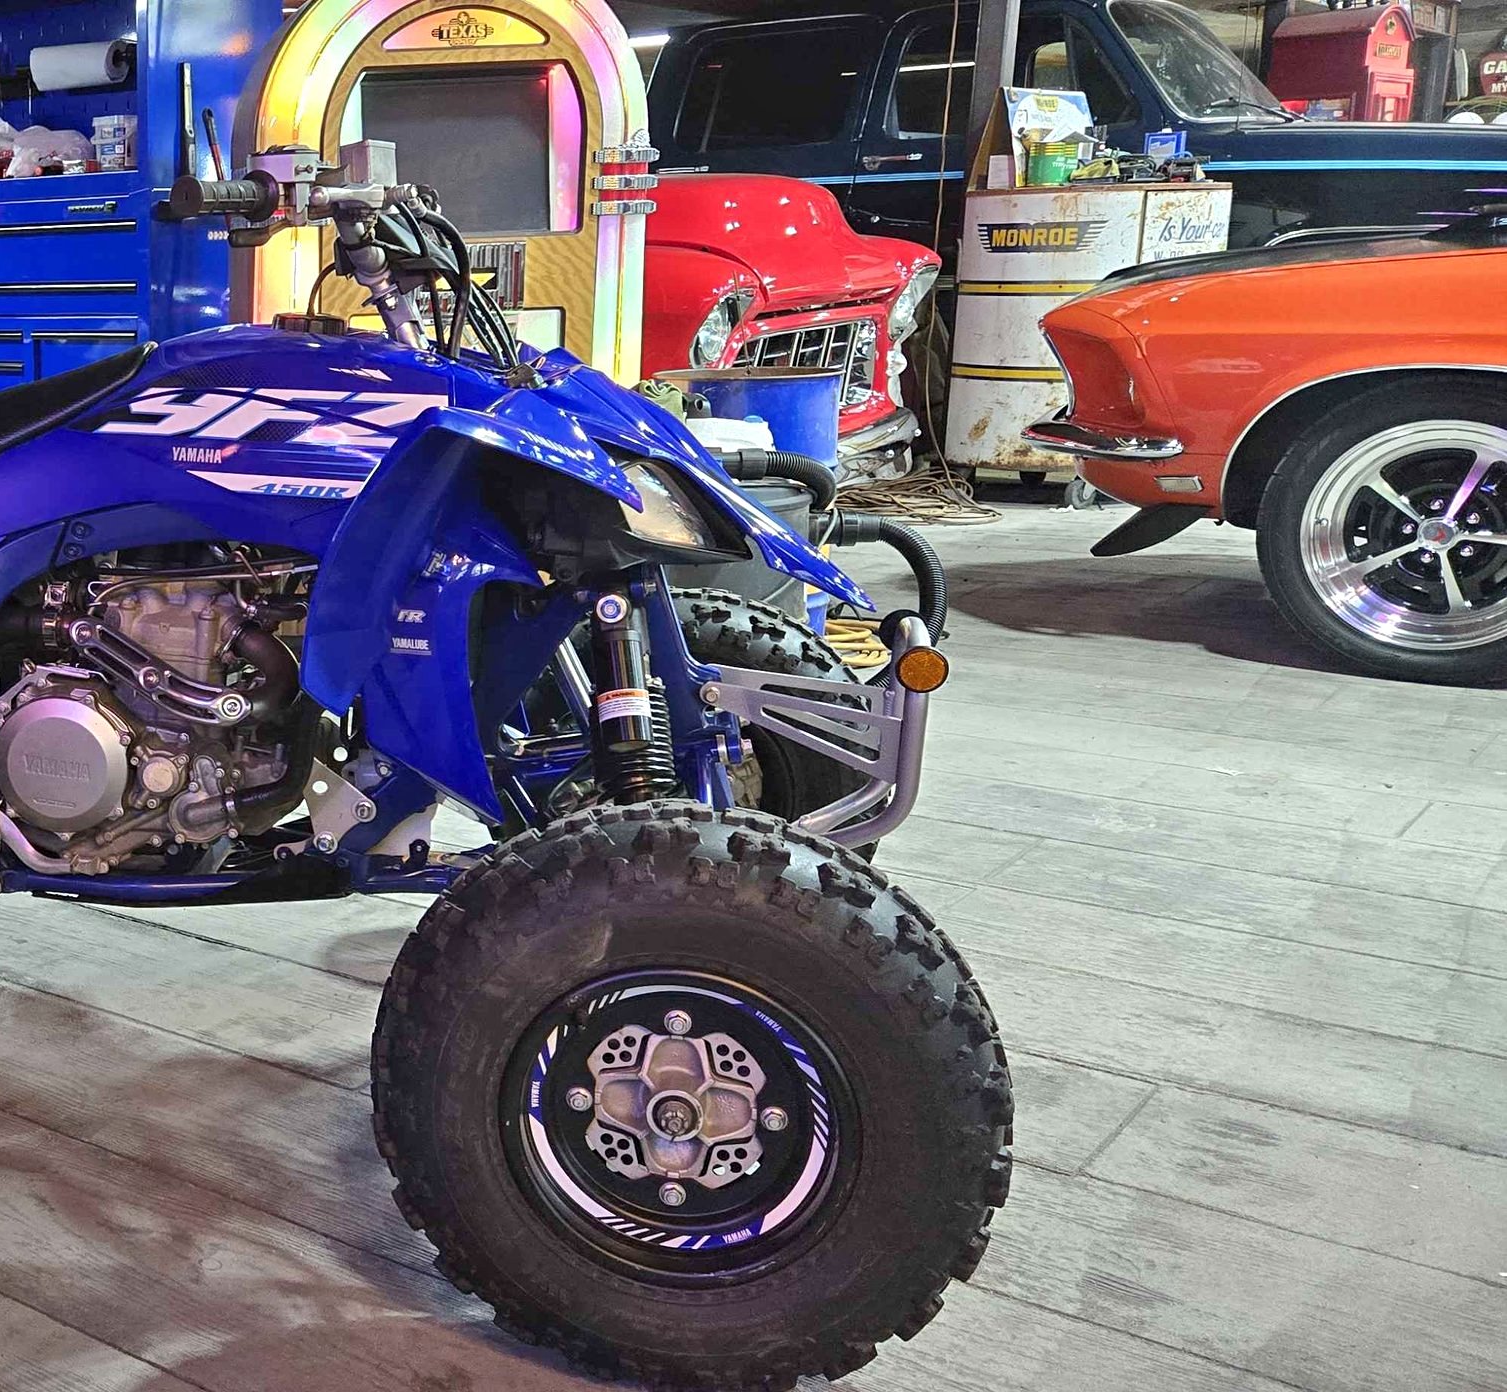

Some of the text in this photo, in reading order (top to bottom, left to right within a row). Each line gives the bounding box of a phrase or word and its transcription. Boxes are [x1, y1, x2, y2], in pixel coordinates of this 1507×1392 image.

[441, 25, 485, 38] TEXAS
[991, 227, 1078, 247] MONROE
[1158, 216, 1176, 242] Is
[92, 386, 450, 447] YFZ
[172, 446, 222, 464] YAMAHA
[251, 482, 351, 499] 450R
[391, 637, 430, 651] YAMALUBE
[23, 753, 93, 784] YAMAHA
[722, 1228, 752, 1244] YAMAHA
